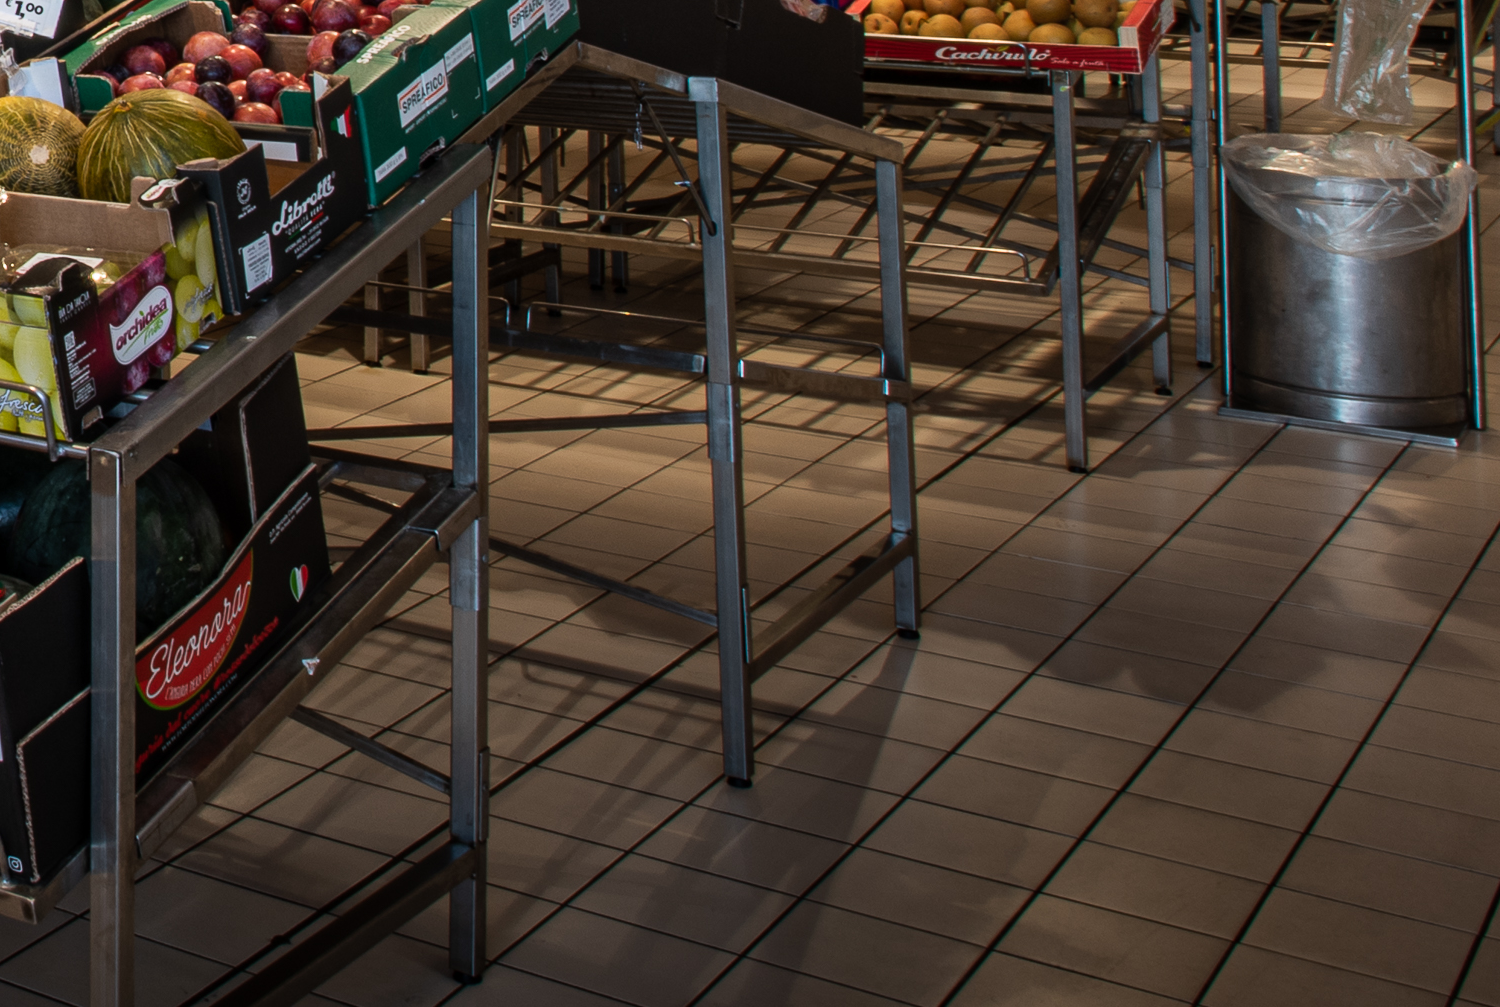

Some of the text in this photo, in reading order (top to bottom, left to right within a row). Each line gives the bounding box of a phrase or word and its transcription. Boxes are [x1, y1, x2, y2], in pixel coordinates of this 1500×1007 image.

[402, 71, 444, 114] SPREAFICO
[115, 297, 169, 351] orchidea
[145, 580, 252, 699] Eleonora
